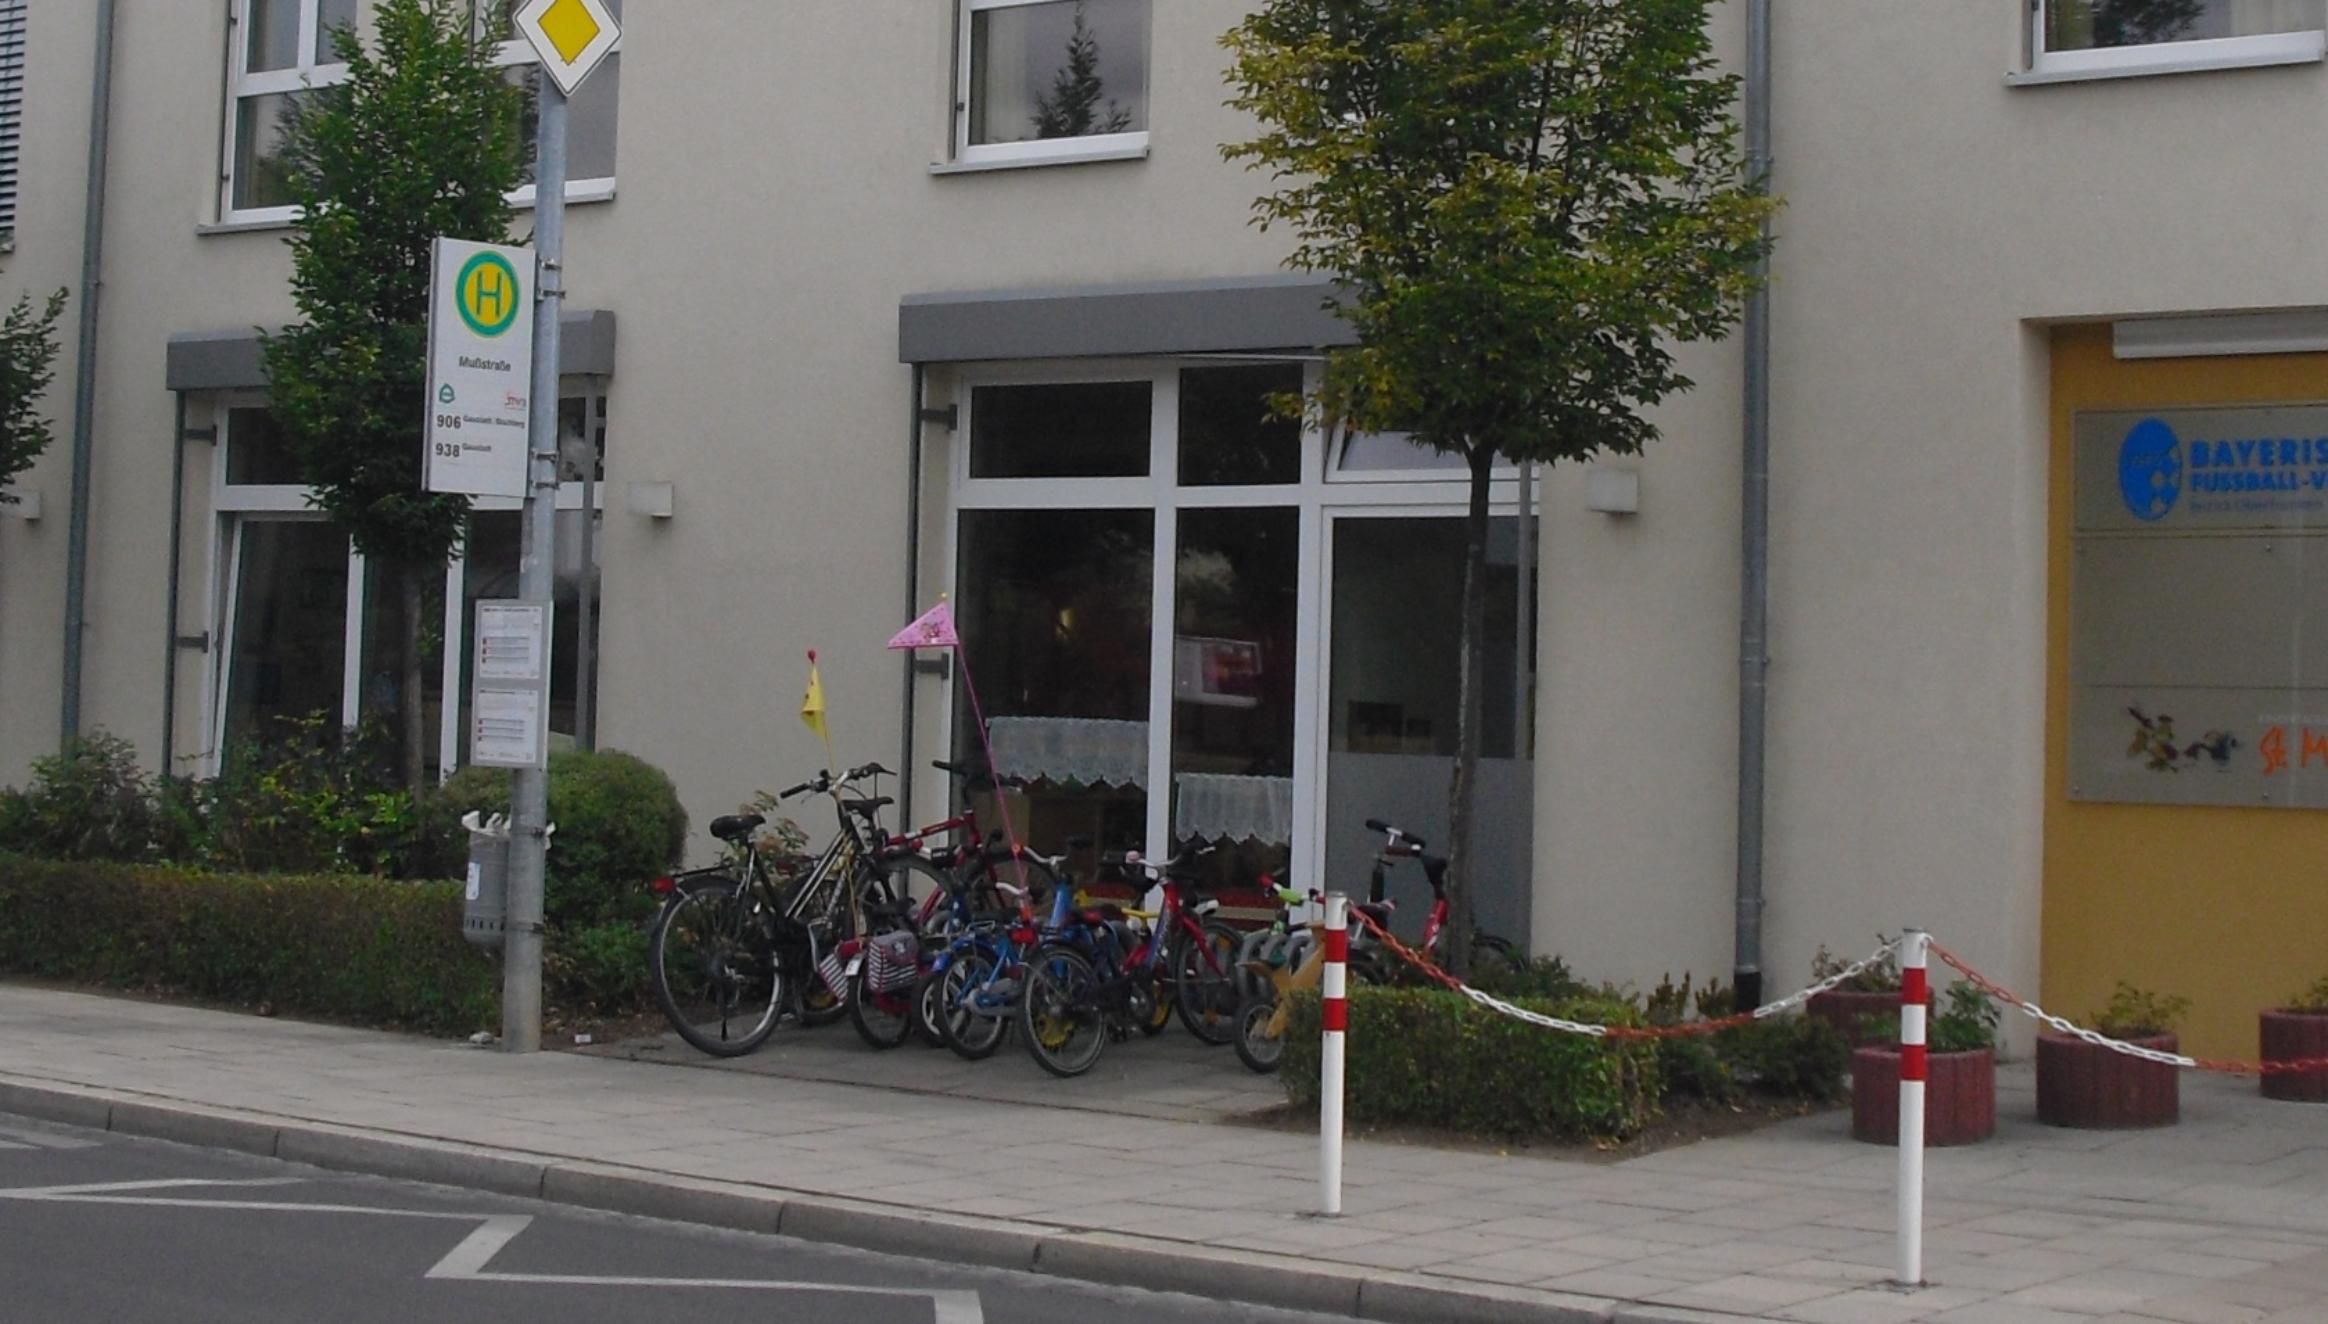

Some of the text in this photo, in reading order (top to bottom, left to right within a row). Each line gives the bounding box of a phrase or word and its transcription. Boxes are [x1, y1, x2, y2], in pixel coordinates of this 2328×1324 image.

[476, 271, 502, 317] H
[459, 356, 511, 372] Mußstraße
[437, 414, 462, 429] 906
[435, 442, 460, 458] 938
[2190, 438, 2328, 469] BAYERIS
